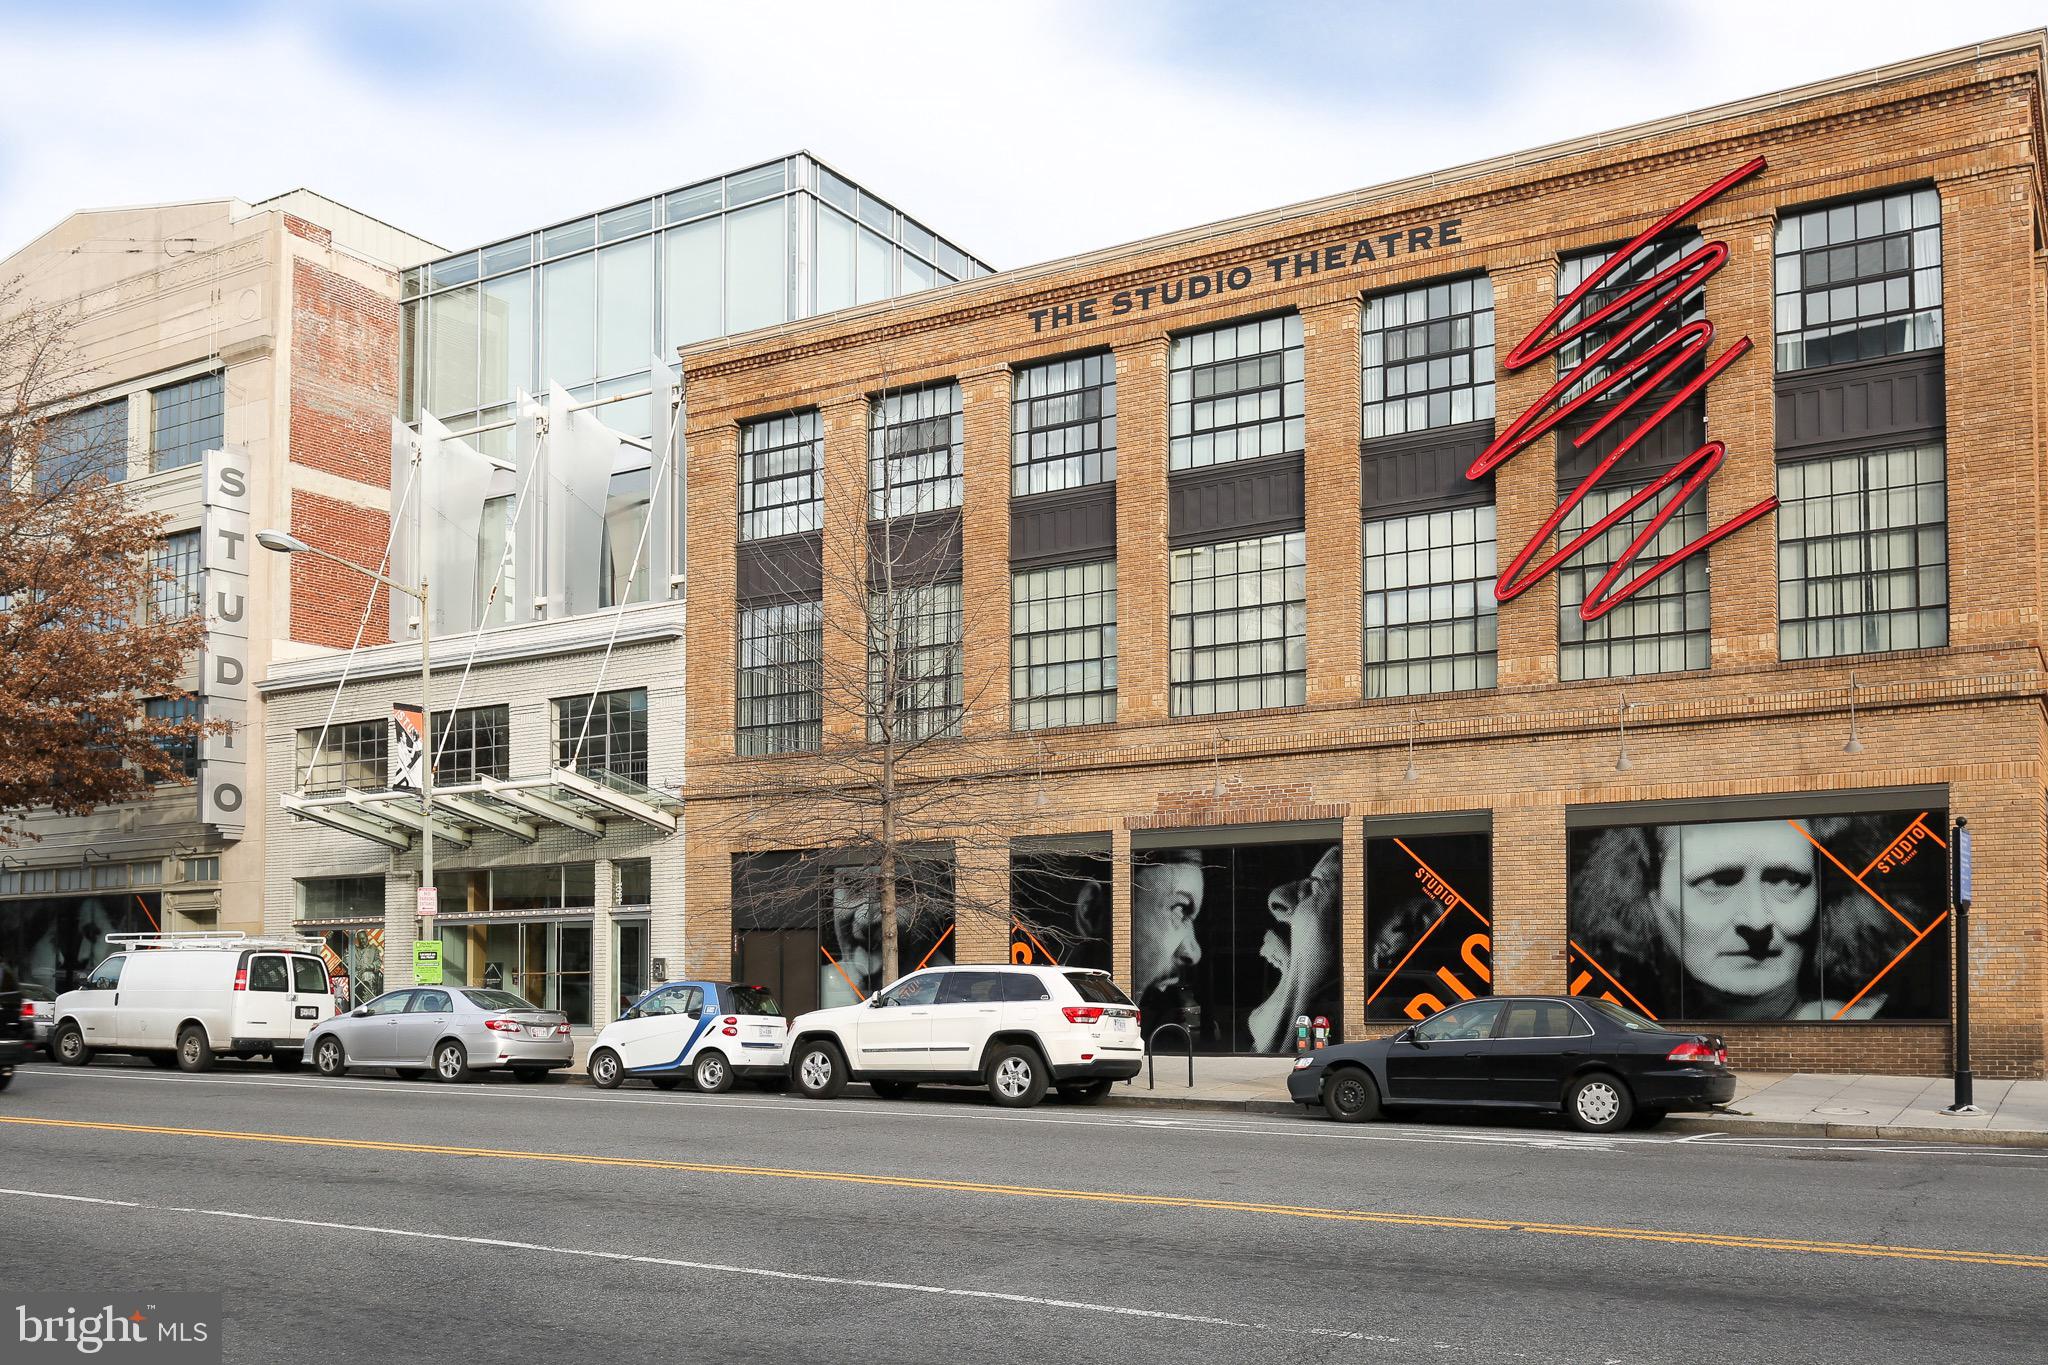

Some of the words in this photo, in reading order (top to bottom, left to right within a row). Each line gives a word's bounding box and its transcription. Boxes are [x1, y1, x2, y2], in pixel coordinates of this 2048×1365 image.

[1028, 296, 1098, 333] THE
[1112, 264, 1252, 317] STUDIO
[1267, 218, 1463, 282] THEATRE
[213, 466, 247, 813] STUDIO
[1414, 867, 1456, 907] STUDIO
[1877, 827, 1926, 874] STUDIO
